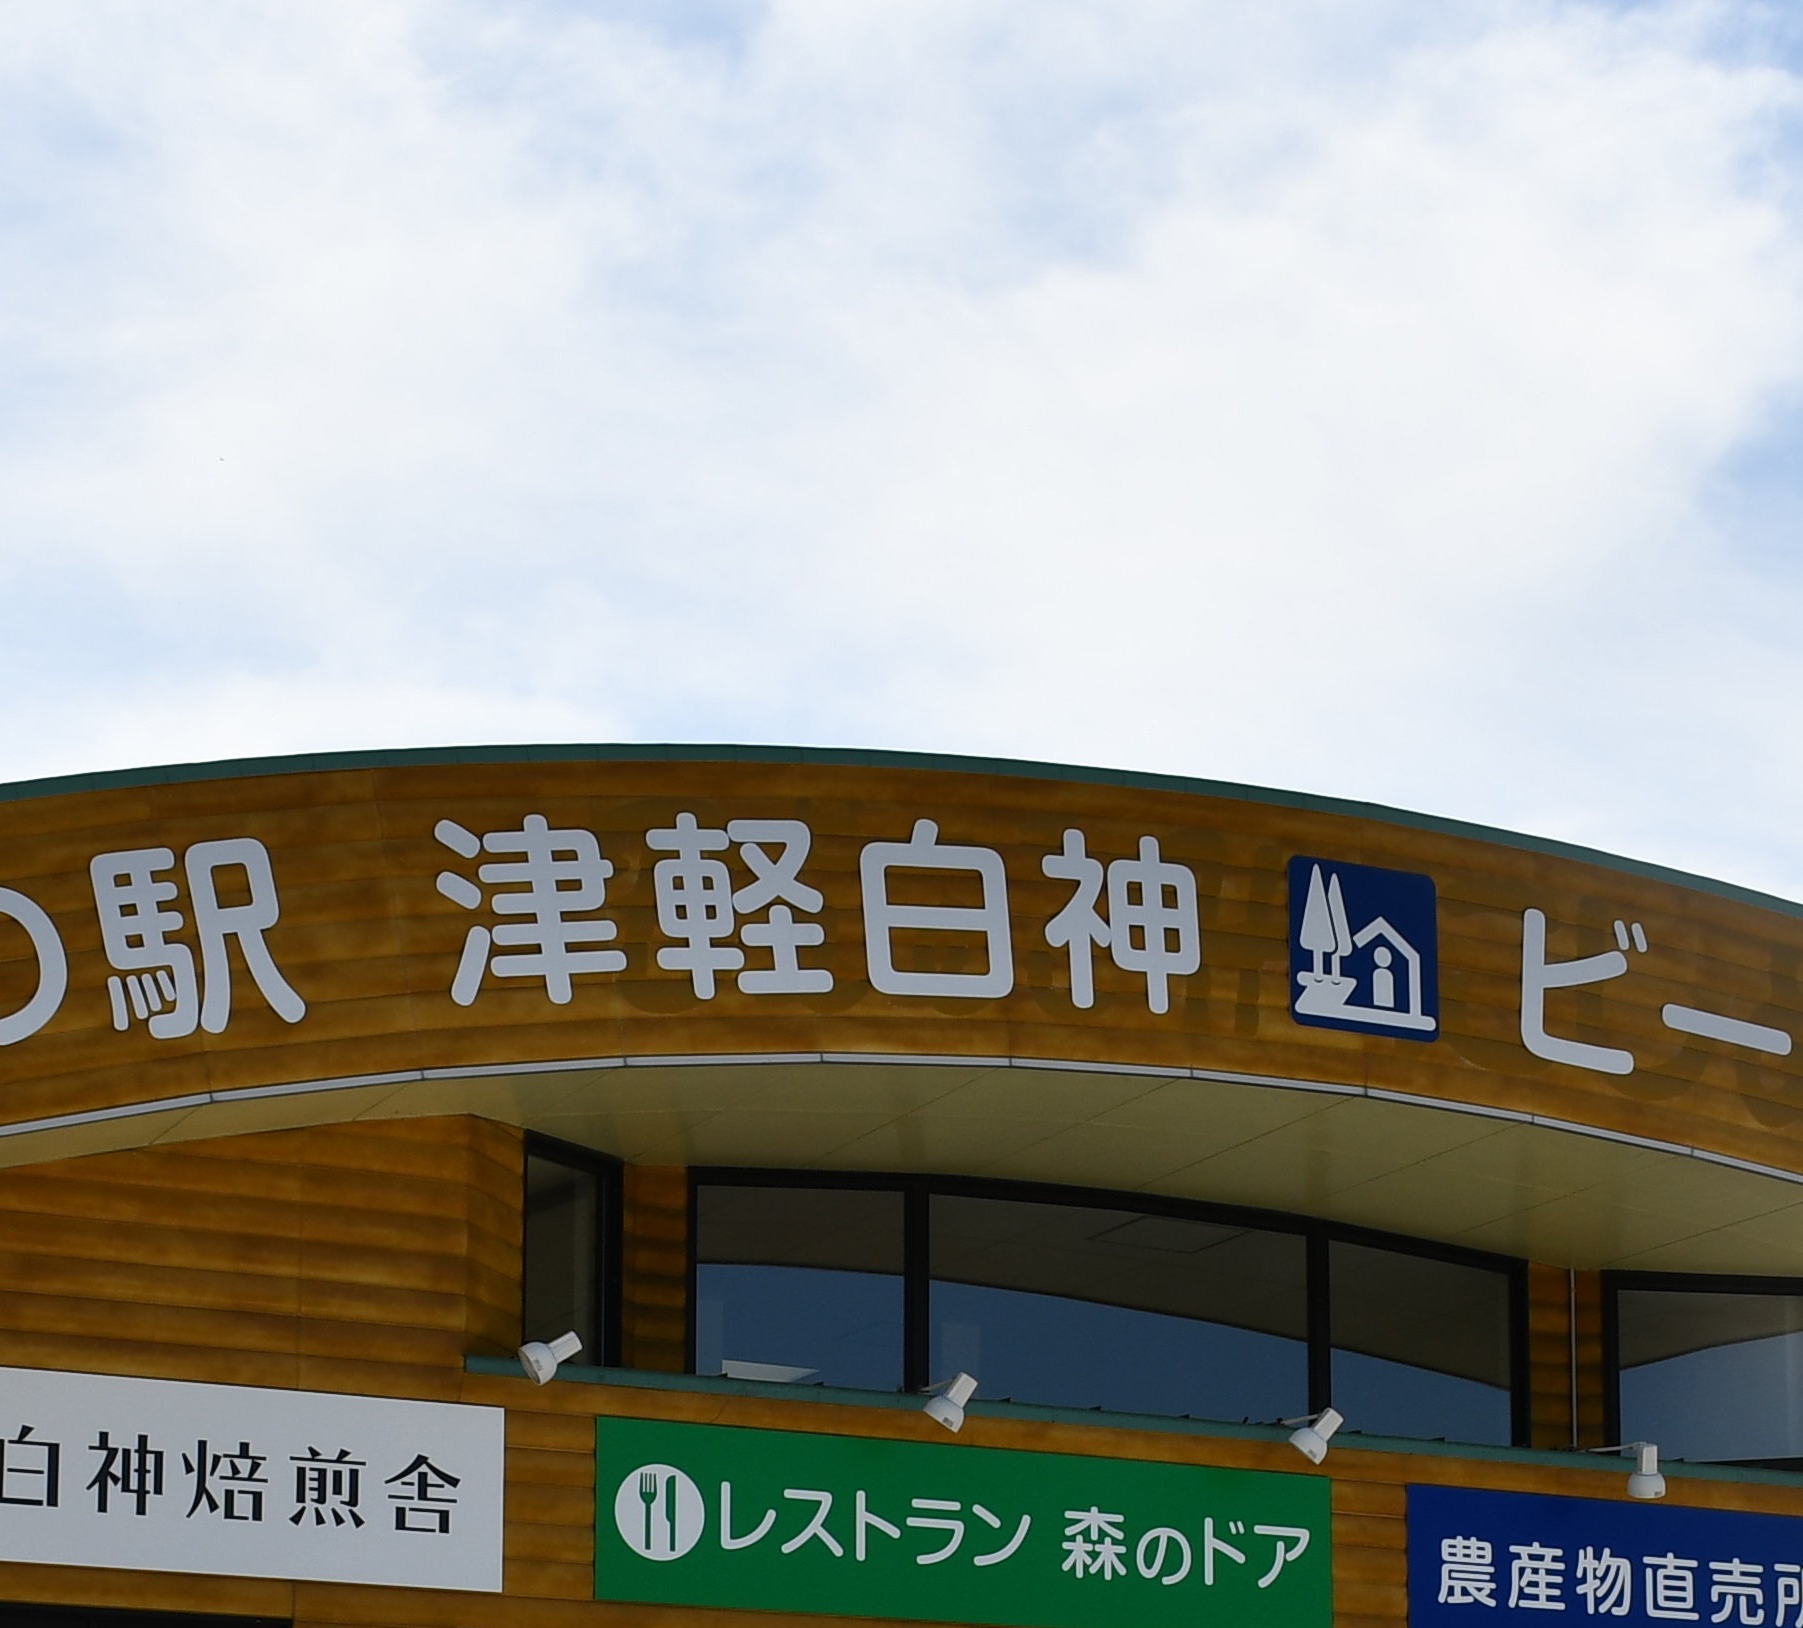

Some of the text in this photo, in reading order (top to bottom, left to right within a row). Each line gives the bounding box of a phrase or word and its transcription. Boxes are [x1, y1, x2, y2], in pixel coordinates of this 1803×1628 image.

[433, 811, 1202, 1016] 津軽白神
[719, 1480, 1311, 1589] レストラン 森のドア
